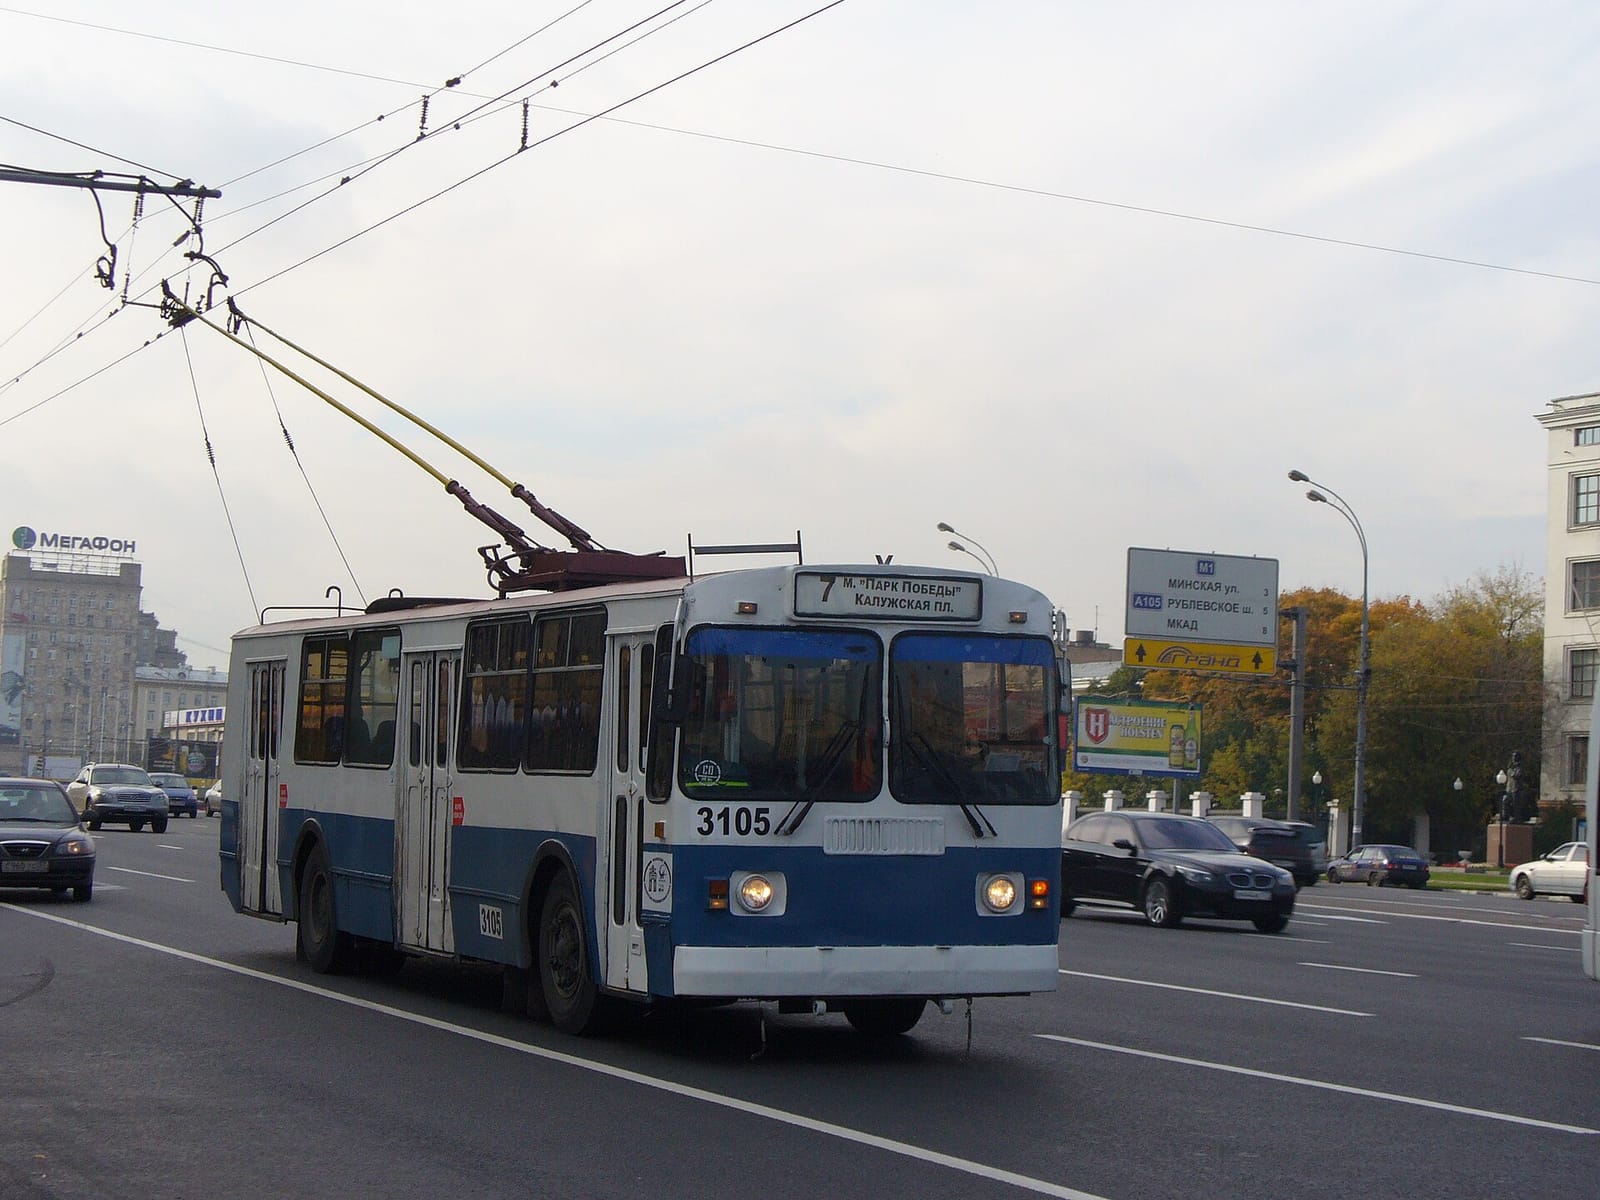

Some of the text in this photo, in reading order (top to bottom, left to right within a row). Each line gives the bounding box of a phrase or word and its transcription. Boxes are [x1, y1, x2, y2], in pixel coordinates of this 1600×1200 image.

[820, 576, 836, 602] 7
[1168, 579, 1269, 597] МИНСКАЯ ул. 3
[1167, 598, 1239, 613] РУБЛЕВСКОЕ
[1242, 606, 1254, 614] ш.
[1263, 608, 1268, 616] 5
[1167, 618, 1199, 631] МКАД
[696, 807, 771, 836] 3105
[481, 908, 501, 936] 3105
